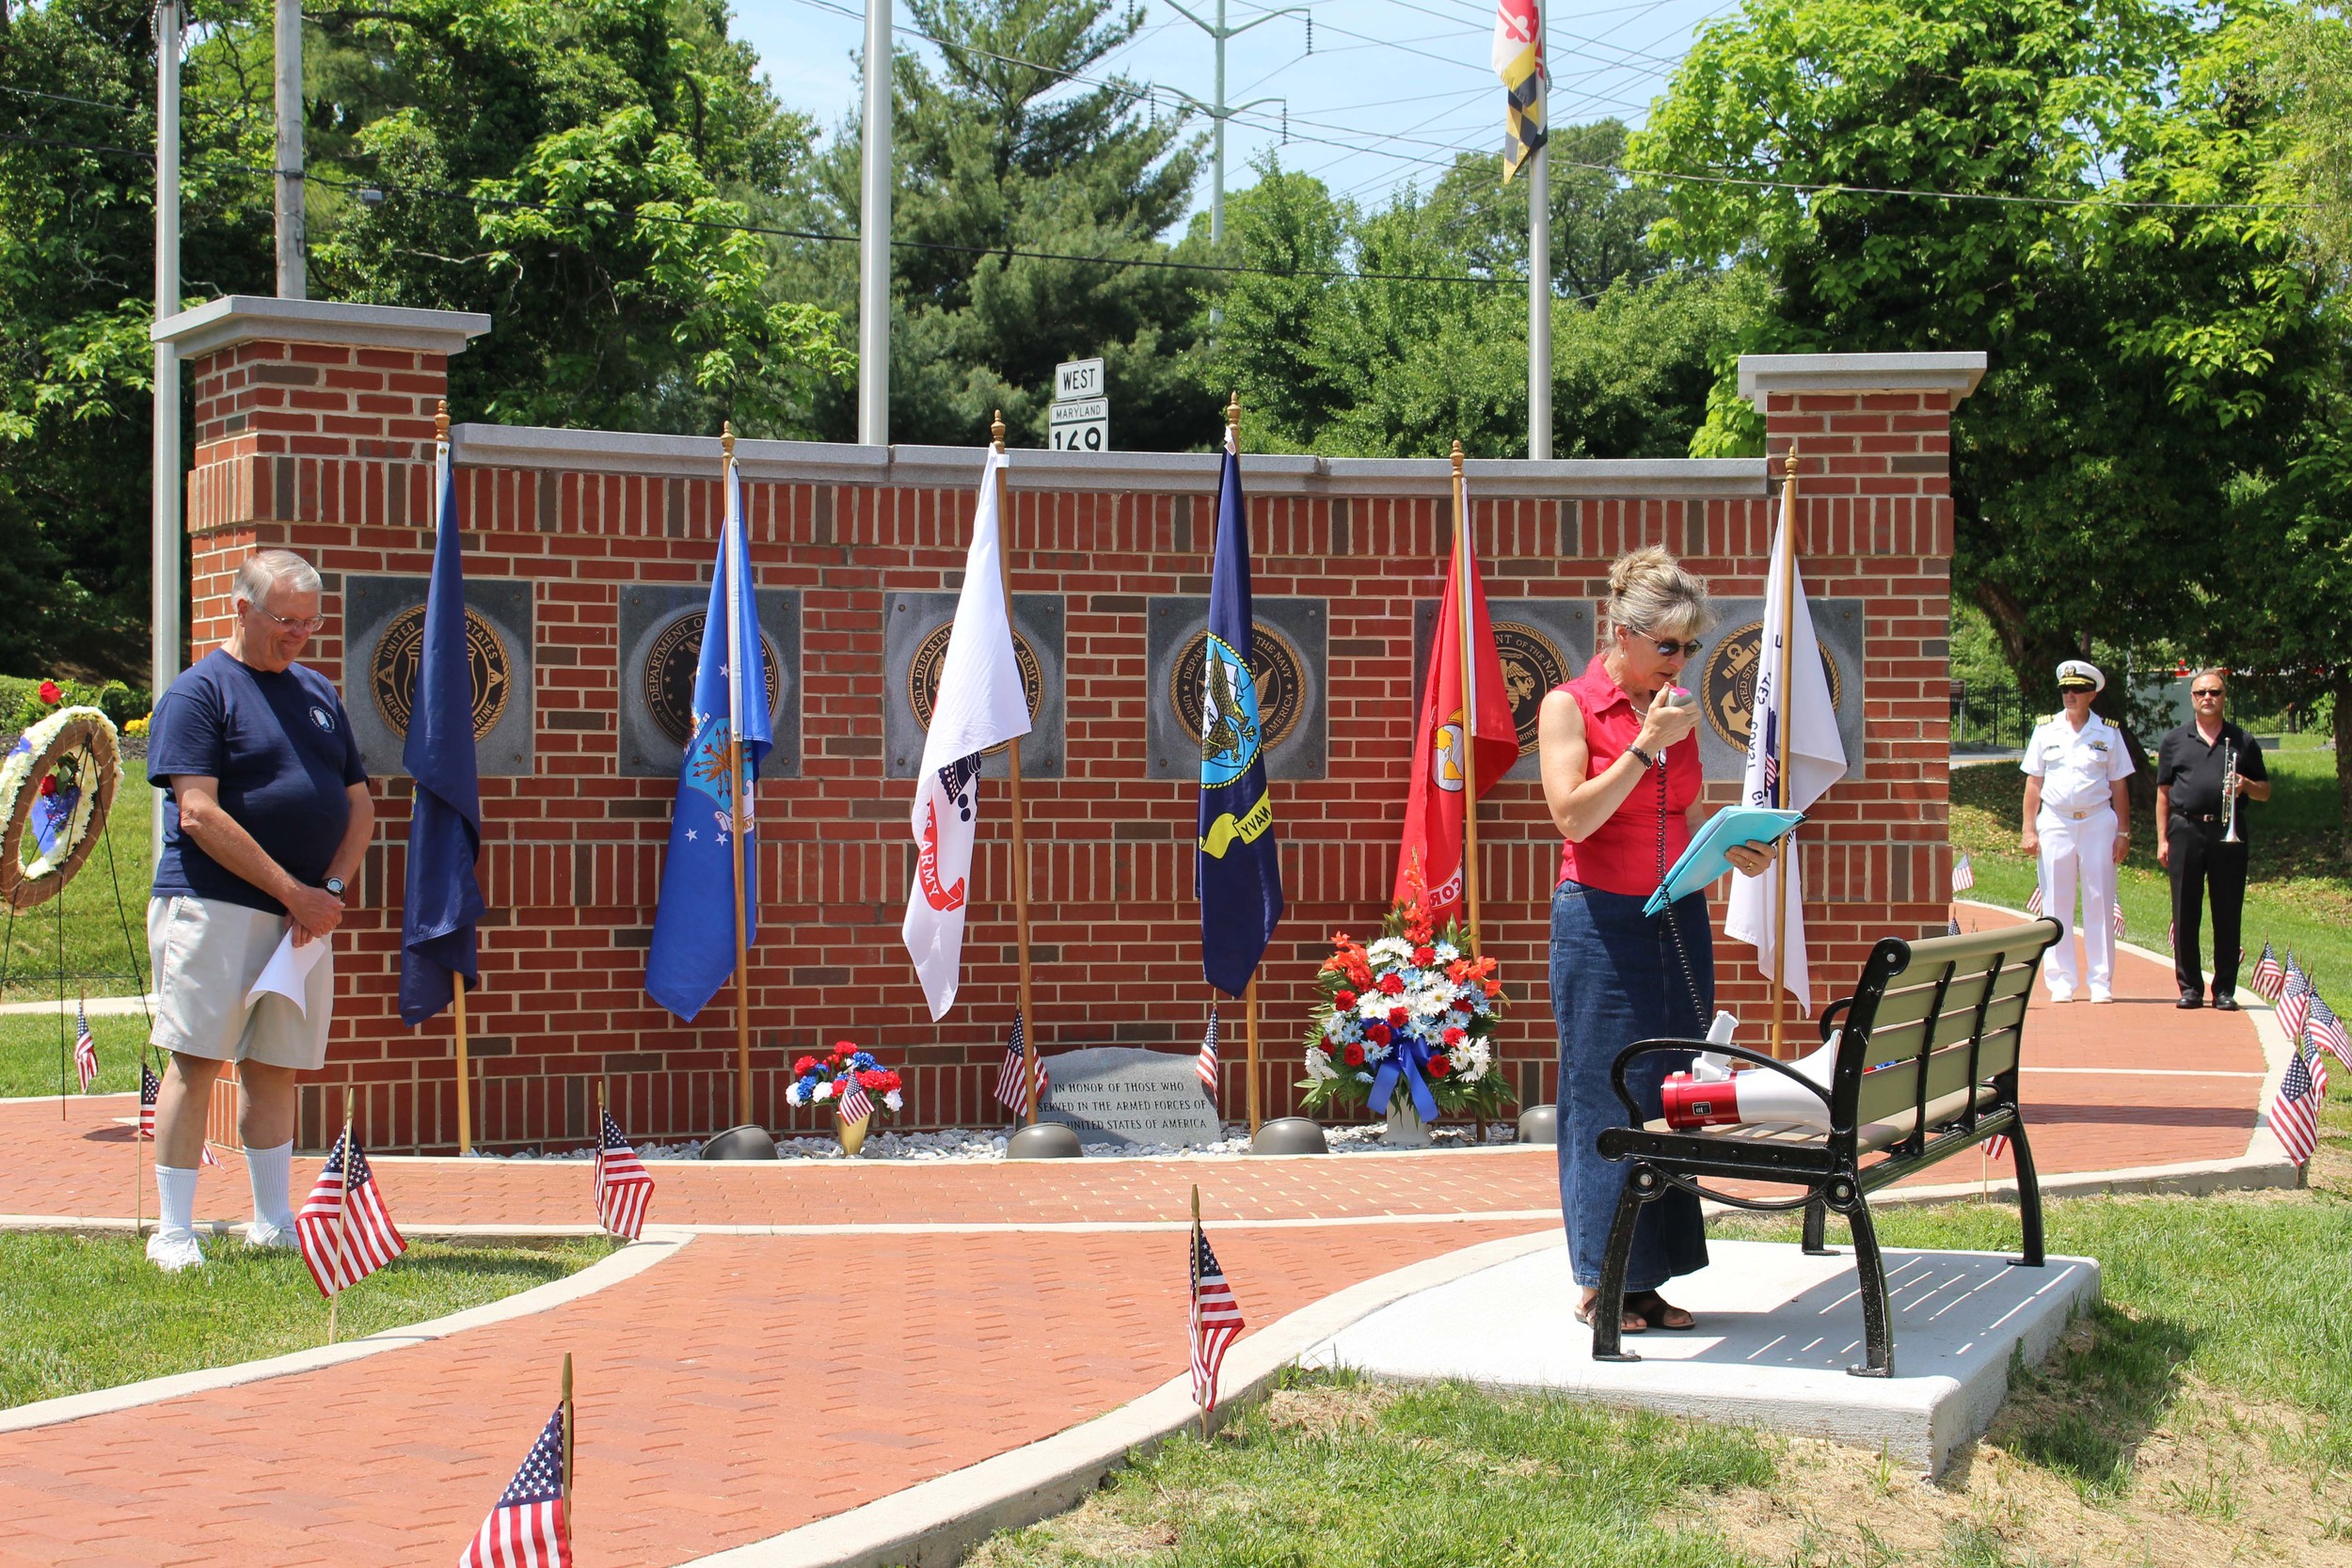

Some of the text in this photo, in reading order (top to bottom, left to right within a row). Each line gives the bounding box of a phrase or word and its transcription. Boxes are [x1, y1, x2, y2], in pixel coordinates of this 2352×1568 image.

[1063, 368, 1095, 391] WEST
[1056, 404, 1102, 420] MARYLAND
[384, 620, 498, 659] UNITED STATES
[648, 623, 689, 702] DEPARTMENT
[915, 629, 1039, 684] DEPARTM ARMY
[1184, 637, 1293, 681] DEPART THE NAVY
[1516, 639, 1528, 649] OF
[1529, 645, 1545, 661] THE
[1543, 659, 1560, 688] NAV
[384, 671, 393, 680] W
[489, 672, 496, 684] E
[383, 692, 496, 731] MERCH ARINE
[660, 713, 682, 736] UNITED
[1265, 693, 1294, 736] AMERICA
[920, 840, 941, 898] ARMY
[1054, 1082, 1184, 1093] IN HONOR OF THOSE WHO
[1038, 1100, 1207, 1113] SERVED IN THE ARMED FORCES OF
[1067, 1121, 1104, 1131] UNITED
[1106, 1119, 1143, 1130] STATES
[1145, 1119, 1158, 1129] OF
[1161, 1118, 1208, 1129] AMERICA
